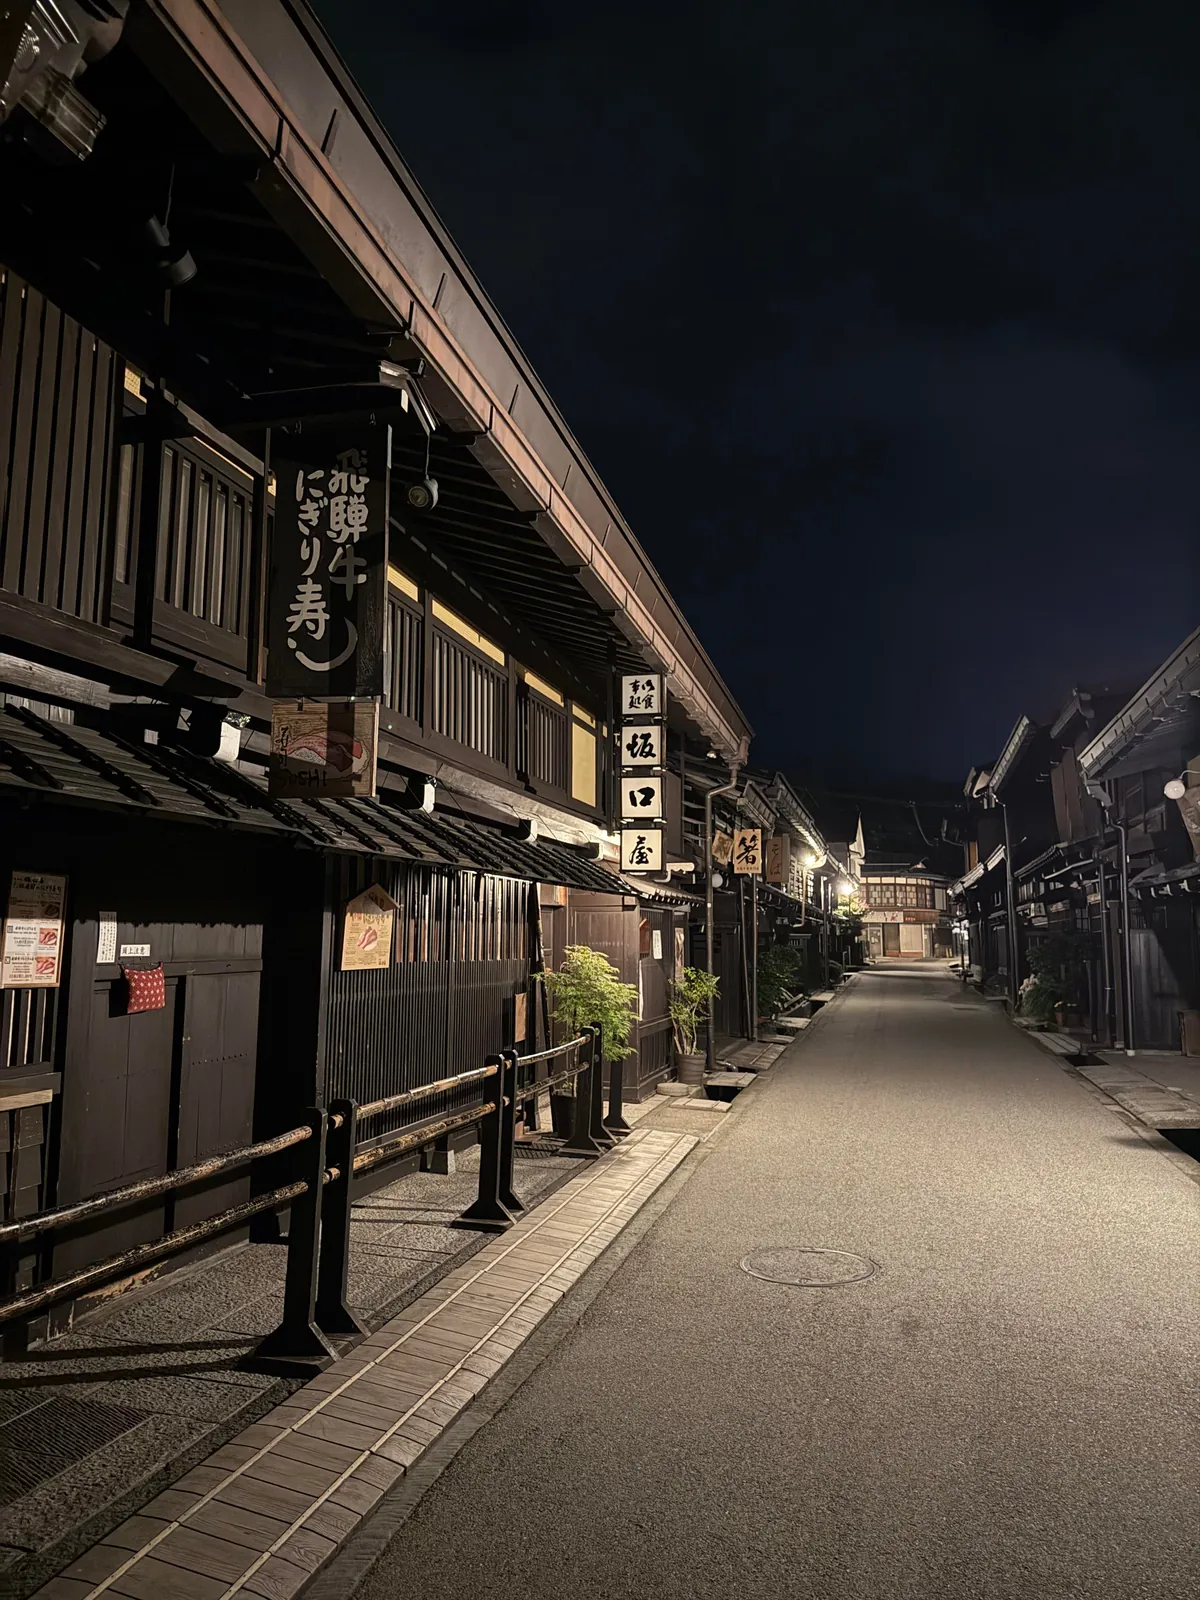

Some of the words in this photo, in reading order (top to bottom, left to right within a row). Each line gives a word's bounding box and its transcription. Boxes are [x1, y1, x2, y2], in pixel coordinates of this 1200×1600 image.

[286, 468, 359, 672] にぎり寿し
[326, 447, 370, 602] 飛騨牛
[626, 732, 657, 865] 坂口屋
[736, 834, 759, 865] 箸
